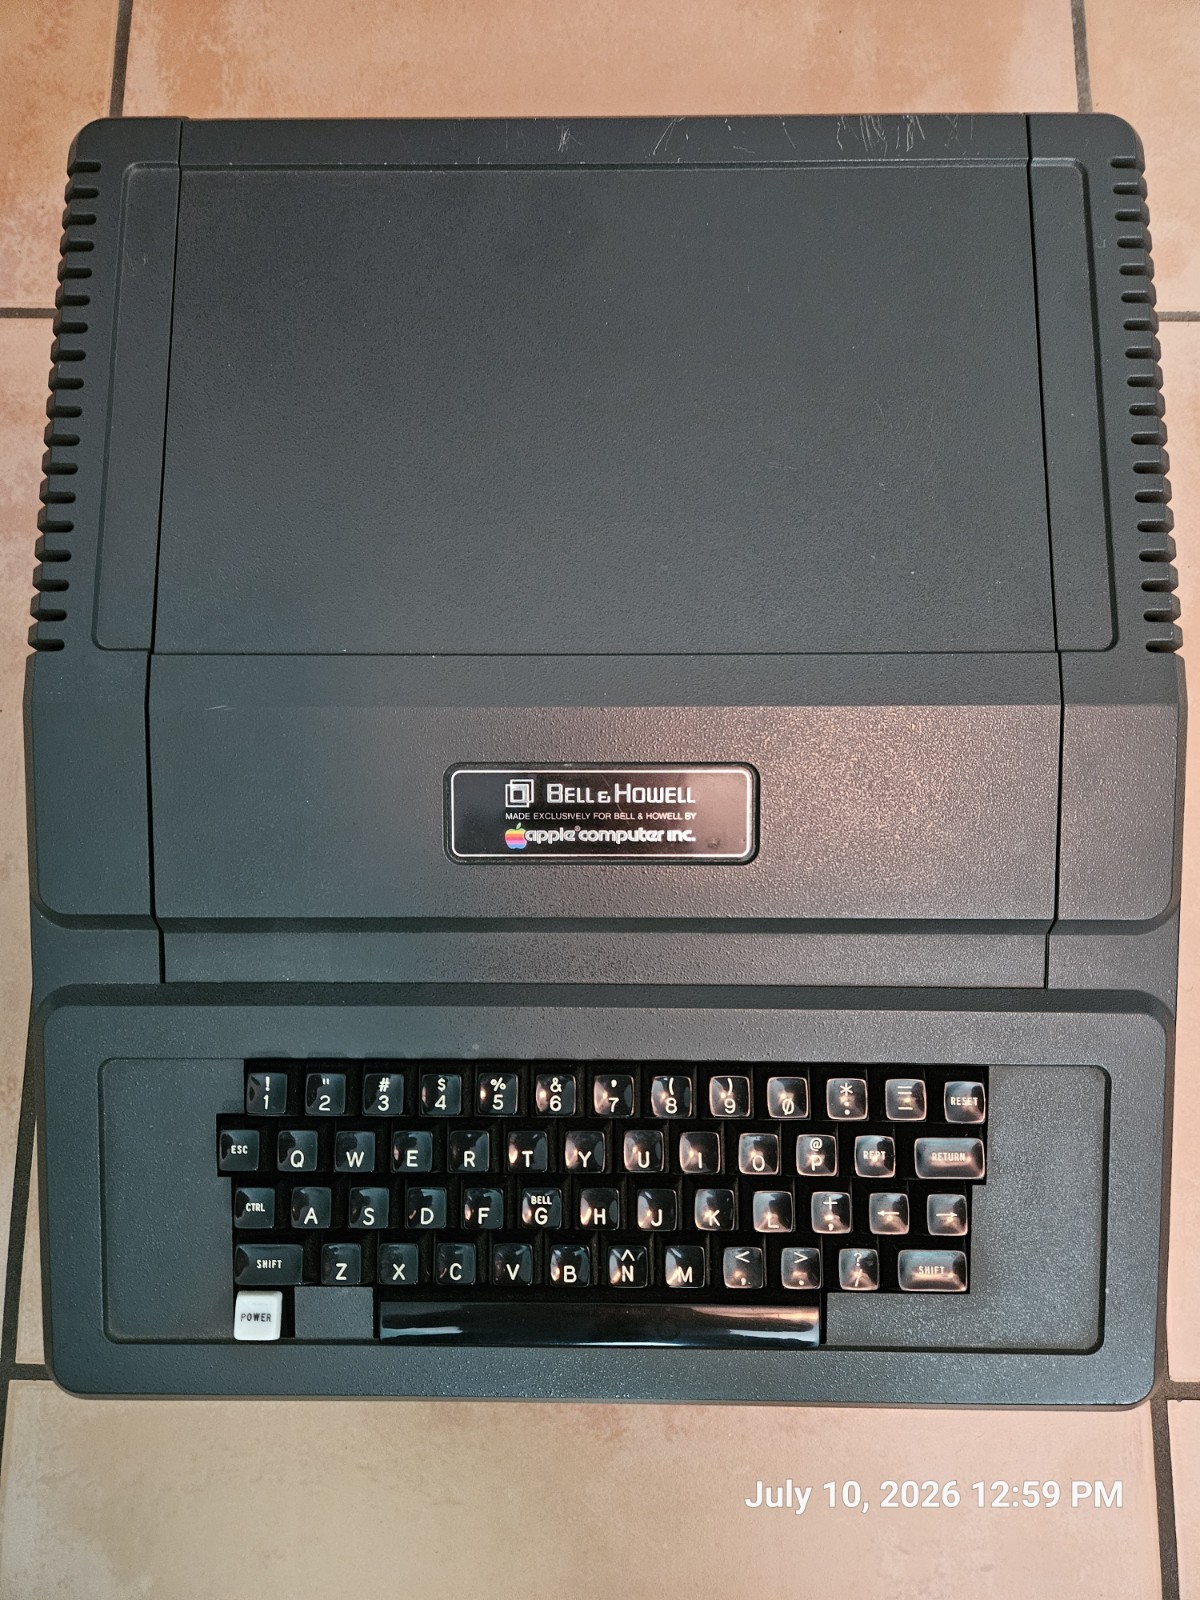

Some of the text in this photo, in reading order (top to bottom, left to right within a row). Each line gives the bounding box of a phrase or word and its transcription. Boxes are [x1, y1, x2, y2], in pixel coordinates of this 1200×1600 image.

[598, 791, 611, 803] &
[578, 827, 664, 844] computer
[378, 1077, 390, 1092] #
[437, 1078, 446, 1090] $
[490, 1078, 507, 1091] %
[550, 1077, 563, 1092] &
[668, 1077, 675, 1095] (
[727, 1078, 733, 1095] )
[263, 1095, 269, 1110] 1
[319, 1095, 330, 1111] 2
[378, 1095, 389, 1111] 3
[434, 1095, 447, 1110] 4
[492, 1095, 504, 1110] 5
[550, 1095, 562, 1110] 6
[608, 1097, 620, 1113] 7
[665, 1098, 677, 1114] 8
[724, 1098, 736, 1114] 9
[950, 1097, 978, 1106] RESET
[231, 1145, 248, 1154] ESC
[810, 1138, 822, 1150] @
[290, 1150, 304, 1168] Q
[346, 1151, 364, 1168] W
[406, 1151, 418, 1167] E
[464, 1151, 475, 1167] R
[522, 1151, 533, 1168] T
[579, 1151, 592, 1168] Y
[638, 1152, 649, 1168] U
[698, 1153, 703, 1168] I
[753, 1155, 765, 1171] O
[811, 1155, 822, 1171] P
[863, 1151, 886, 1160] REPT
[932, 1153, 966, 1161] RETURN
[246, 1203, 265, 1212] CTRL
[531, 1196, 552, 1205] BELL
[304, 1207, 318, 1224] A
[363, 1208, 375, 1225] S
[421, 1208, 434, 1224] D
[478, 1208, 490, 1225] F
[535, 1207, 548, 1225] G
[594, 1208, 606, 1225] H
[651, 1209, 662, 1227] J
[709, 1210, 721, 1227] K
[767, 1214, 779, 1229] L
[257, 1260, 282, 1268] SHIFT
[735, 1251, 750, 1263] <
[794, 1252, 808, 1264] >
[854, 1252, 863, 1266] ?
[336, 1263, 347, 1281] Z
[393, 1263, 405, 1281] X
[450, 1263, 462, 1281] C
[506, 1264, 520, 1281] V
[564, 1265, 576, 1282] B
[621, 1266, 634, 1282] N
[677, 1267, 692, 1282] M
[919, 1266, 945, 1274] SHIFT
[241, 1313, 271, 1322] POWER
